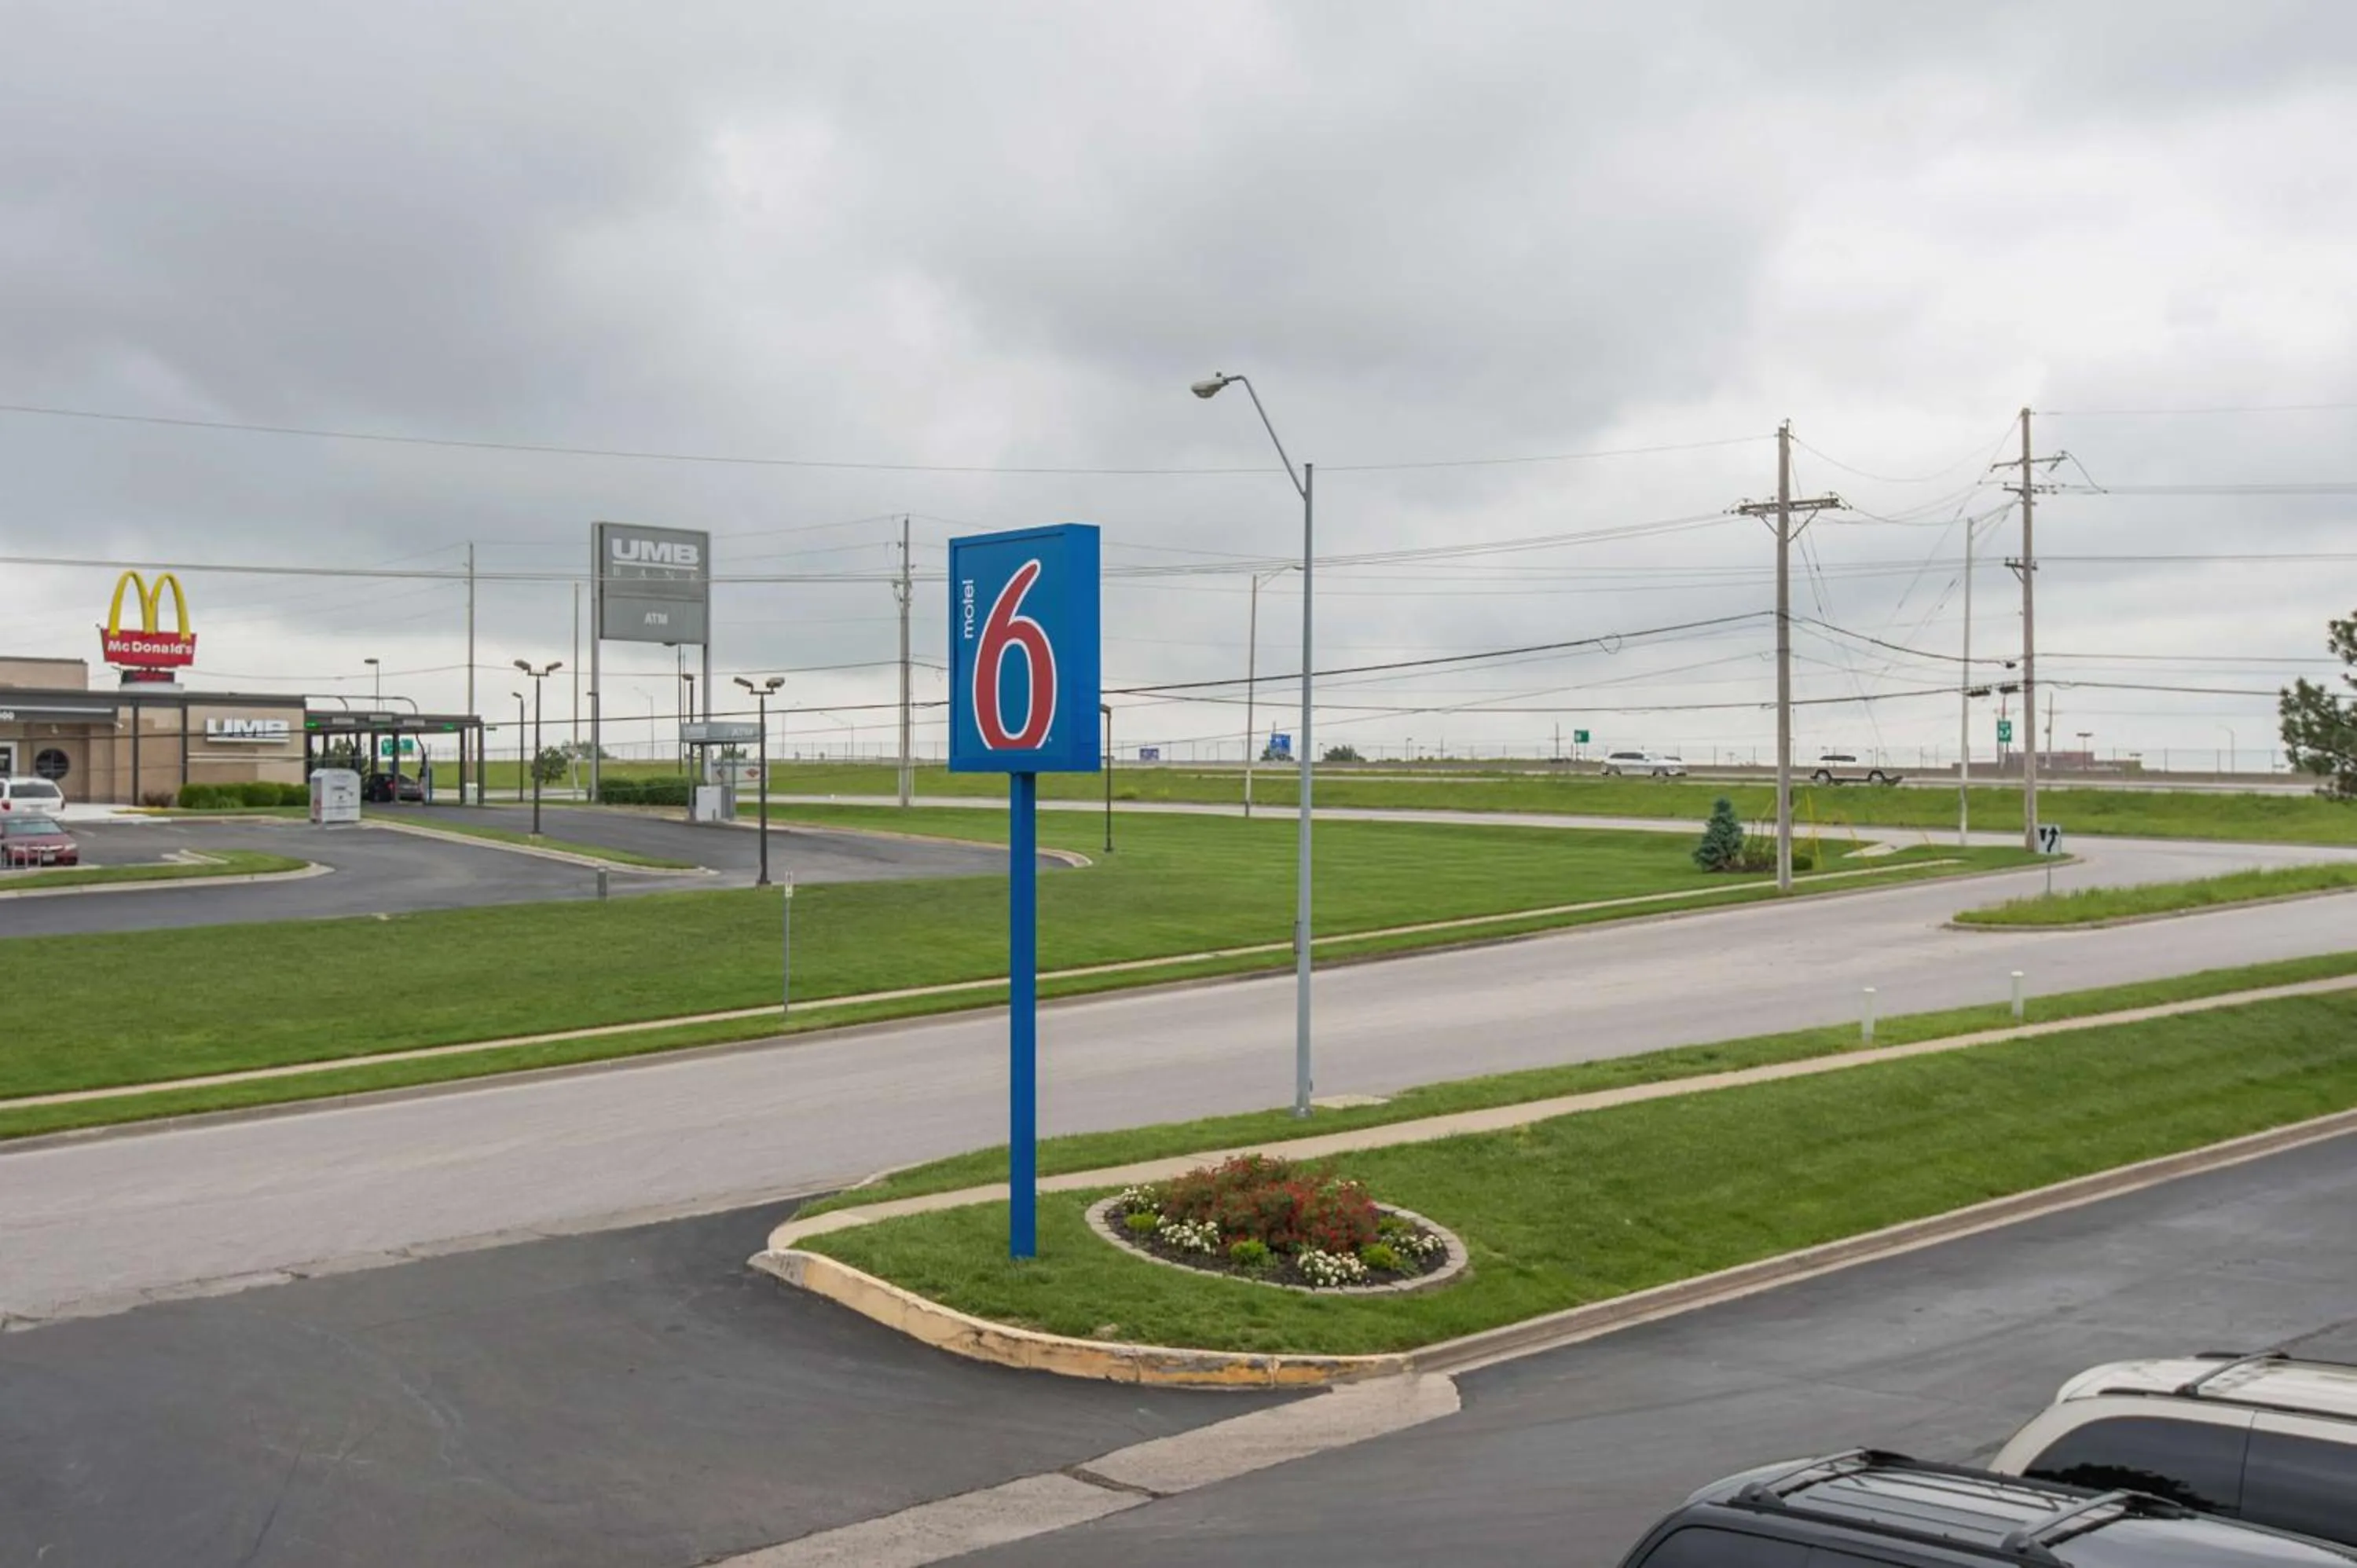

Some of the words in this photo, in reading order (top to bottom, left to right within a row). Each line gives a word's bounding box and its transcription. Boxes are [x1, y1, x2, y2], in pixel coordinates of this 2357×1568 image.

[612, 538, 699, 564] UMB
[644, 612, 668, 625] ATM
[962, 579, 974, 639] motel
[108, 640, 192, 656] McDonald's
[973, 559, 1057, 749] 6
[206, 718, 289, 737] UMB
